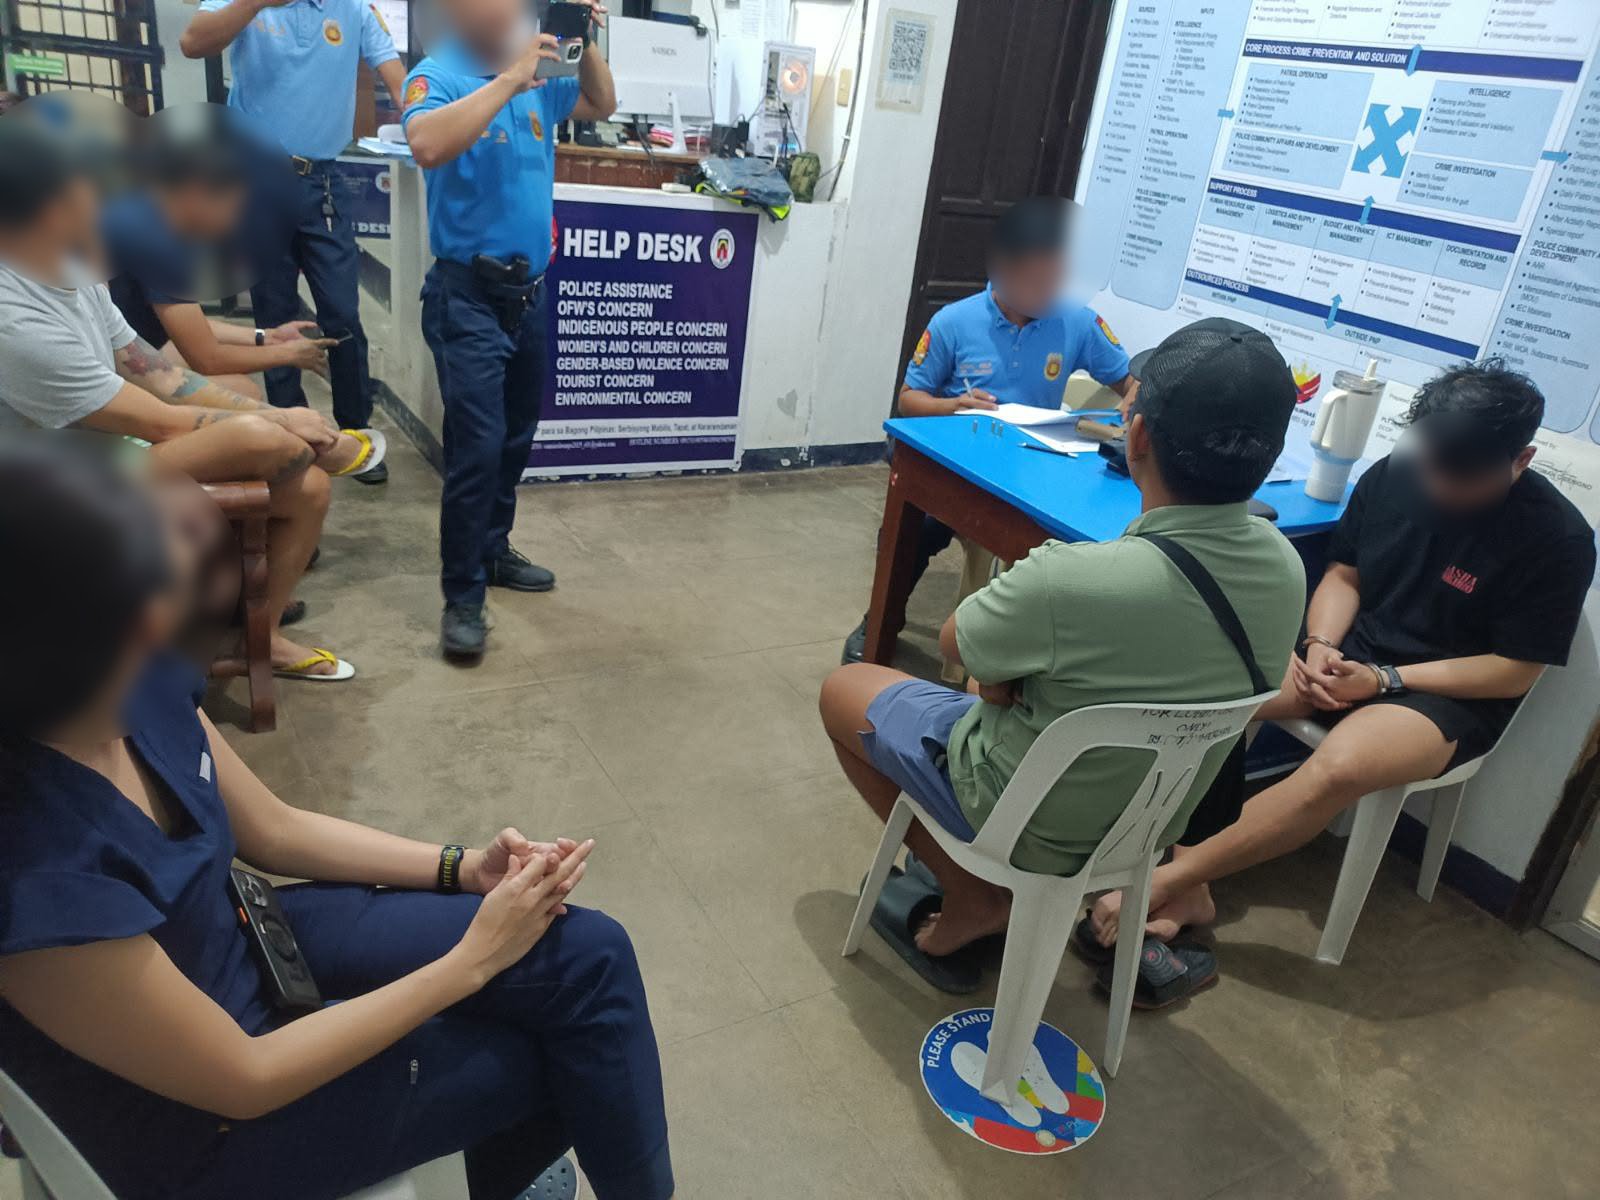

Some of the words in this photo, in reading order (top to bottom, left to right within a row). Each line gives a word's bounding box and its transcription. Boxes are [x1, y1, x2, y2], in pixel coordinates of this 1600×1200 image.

[1246, 43, 1262, 52] CORE
[1312, 47, 1353, 60] PREVENTION
[1354, 51, 1372, 60] AND
[1371, 52, 1408, 64] SOLUTION
[1280, 69, 1298, 77] PATROL
[1298, 71, 1328, 79] OPERATIONS
[1469, 88, 1512, 98] INTELLIGENCE
[1236, 132, 1250, 140] POLICE
[1250, 134, 1276, 144] COMMUNITY
[1276, 138, 1294, 146] AFFAIRS
[1304, 142, 1340, 152] DEVELOPMENT
[1434, 162, 1452, 172] CRIME
[1453, 166, 1496, 178] INVESTIGATION
[1209, 182, 1232, 193] SUPPORT
[1232, 185, 1258, 198] PROCESS
[1224, 199, 1245, 210] RESOURCE
[1216, 208, 1244, 218] MANAGEMENT
[1266, 208, 1287, 218] LOGISTICS
[1298, 214, 1316, 224] SUPPLY
[1272, 220, 1303, 230] MANAGEMENT
[1324, 220, 1342, 229] BUDGET
[1343, 222, 1354, 232] AND
[1354, 224, 1376, 236] FINANCE
[563, 228, 630, 259] HELP
[636, 232, 704, 263] DESK
[1330, 231, 1363, 244] MANAGEMENT
[1386, 232, 1396, 240] ICT
[1396, 234, 1432, 248] MANAGEMENT
[1446, 244, 1494, 260] DOCUMENTATION
[1494, 255, 1508, 263] AND
[1530, 248, 1578, 264] DEVELOPMENT
[1534, 240, 1558, 251] POLICE
[1557, 244, 1598, 258] COMMUNITY
[1459, 258, 1486, 270] RECORDS
[1187, 268, 1222, 286] OUTSOURCED
[1223, 280, 1250, 293] PROCESS
[559, 280, 602, 296] POLICE
[603, 282, 673, 299] ASSISTANCE
[558, 300, 596, 316] OFW'S
[598, 302, 653, 318] CONCERN
[558, 318, 628, 336] INDIGENOUS
[630, 320, 674, 336] PEOPLE
[676, 322, 728, 338] CONCERN
[1504, 317, 1524, 328] CRIME
[1524, 322, 1572, 340] INVESTIGATION
[1344, 329, 1368, 342] OUTSIDE
[1369, 335, 1381, 345] PNP
[558, 339, 606, 354] WOMEN'S
[608, 341, 630, 354] AND
[631, 341, 680, 354] CHILDREN
[682, 341, 727, 354] CONCERN
[556, 357, 634, 371] GENDER-BASED
[636, 358, 683, 371] VIOLENCE
[684, 358, 729, 371] CONCERN
[556, 374, 602, 388] TOURIST
[604, 374, 654, 388] CONCERN
[555, 392, 642, 406] ENVIRONMENTAL
[643, 391, 692, 405] CONCERN
[926, 1028, 950, 1068] PLEASE
[947, 1012, 991, 1033] STAND
